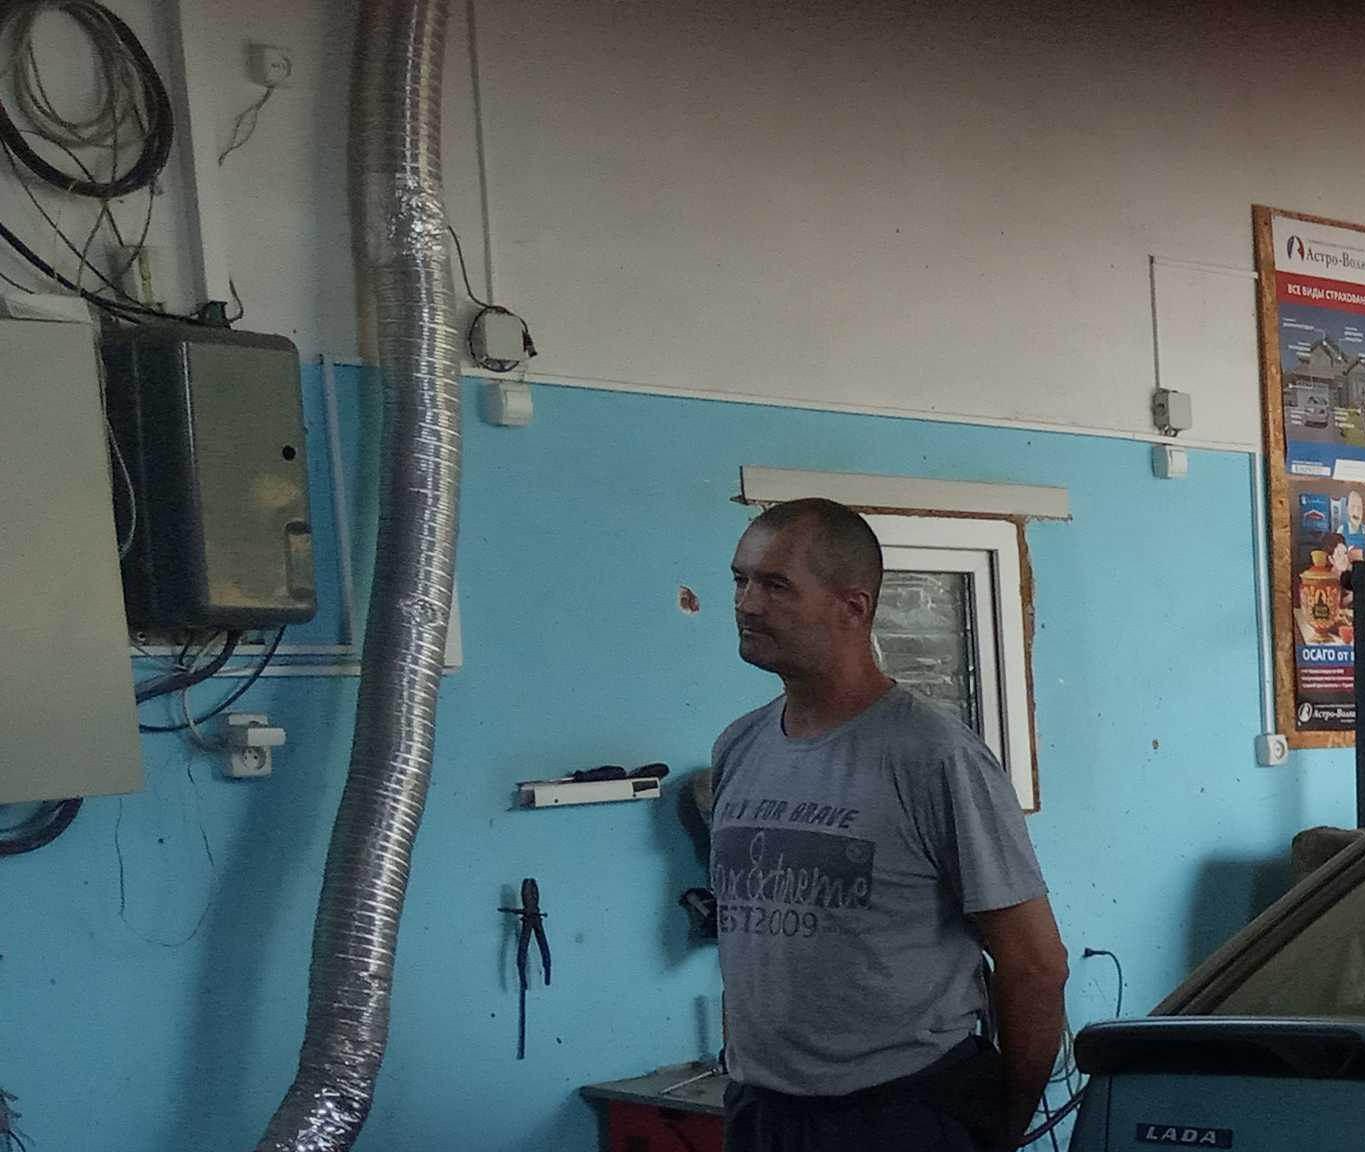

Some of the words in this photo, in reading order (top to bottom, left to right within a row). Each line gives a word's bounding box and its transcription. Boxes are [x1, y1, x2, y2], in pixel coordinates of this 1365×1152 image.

[1287, 283, 1301, 295] ВСЕ
[1302, 649, 1335, 661] ОСАГО
[1337, 651, 1349, 661] от
[754, 799, 788, 822] FOR
[788, 801, 860, 829] BRAVE
[1145, 1125, 1217, 1144] LADA
